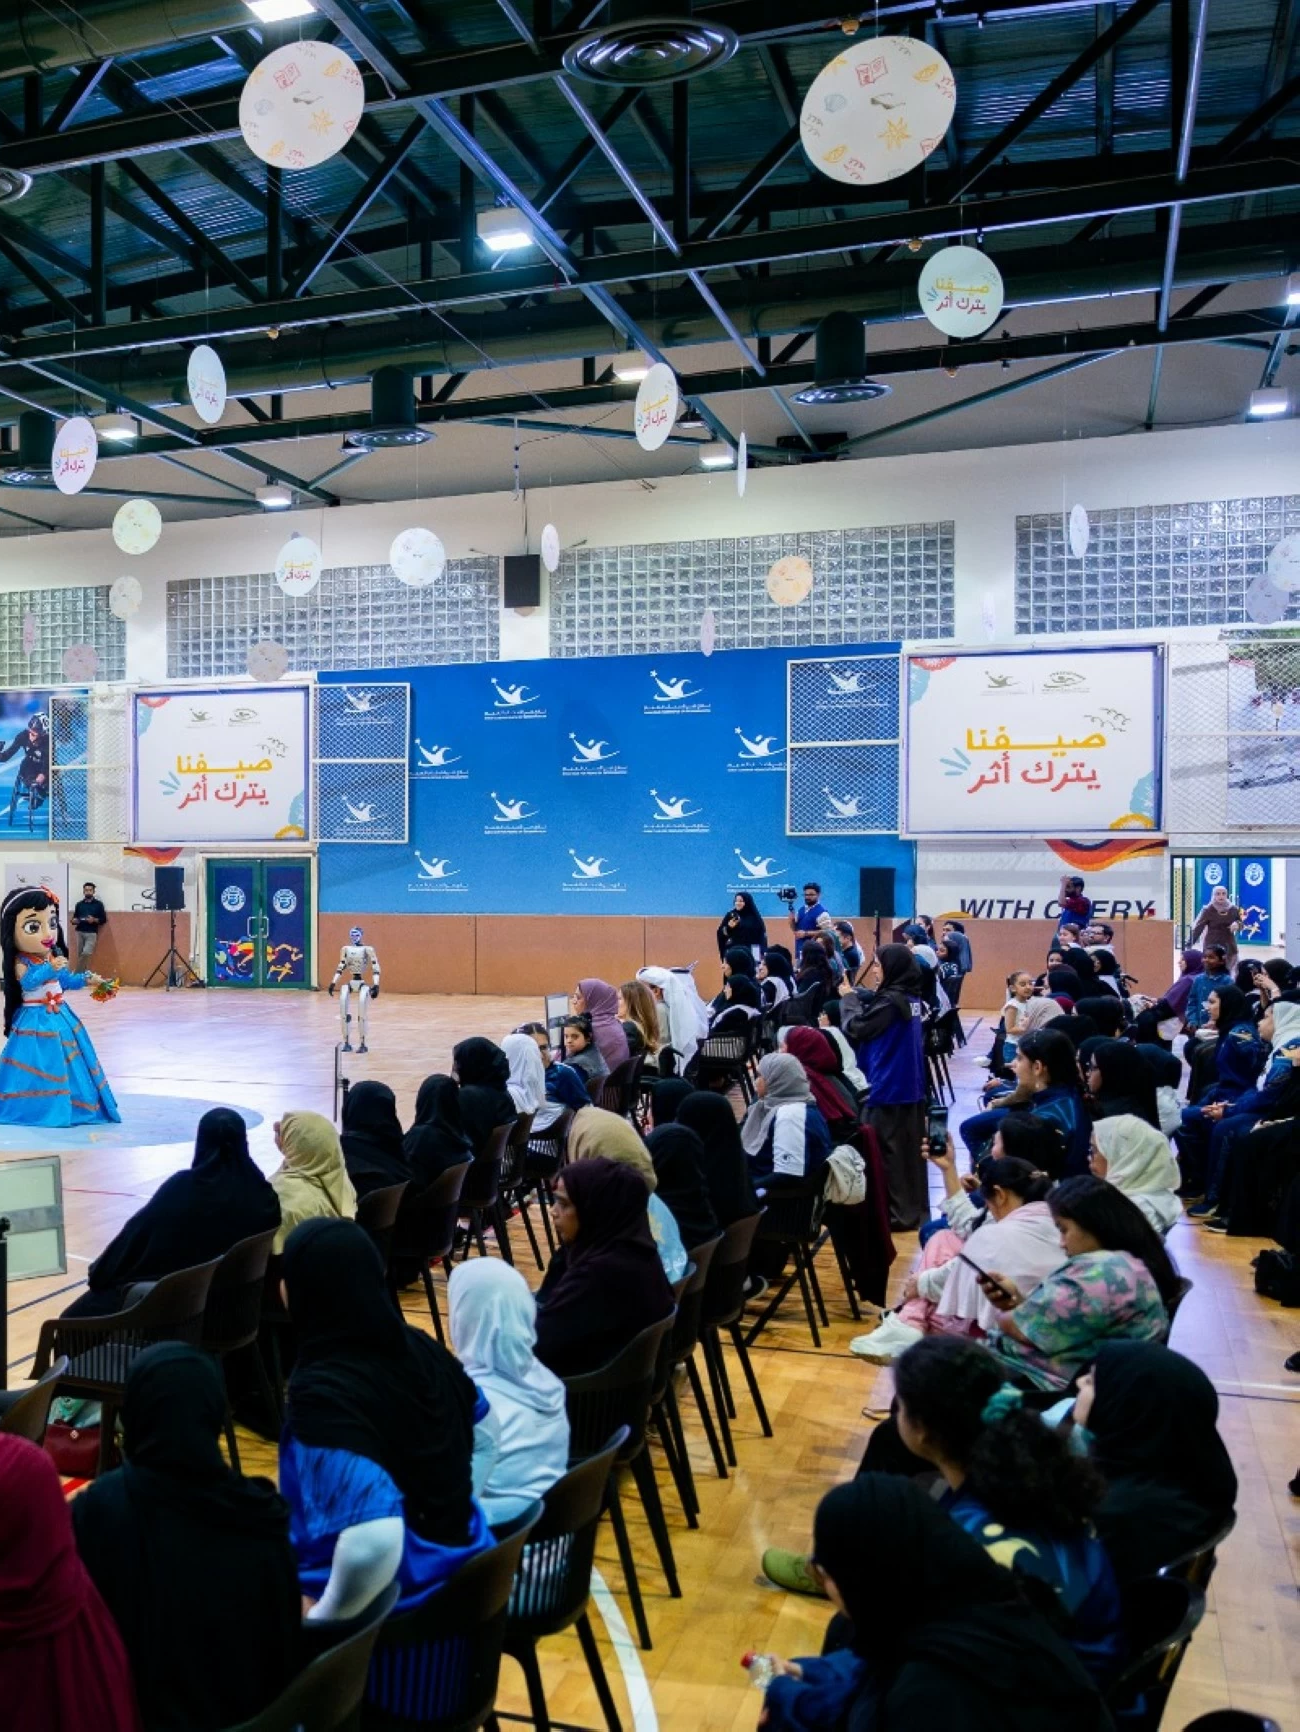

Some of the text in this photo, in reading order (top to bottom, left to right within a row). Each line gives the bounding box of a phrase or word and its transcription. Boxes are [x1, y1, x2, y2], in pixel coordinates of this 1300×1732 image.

[935, 277, 990, 294] صيفنا
[936, 293, 987, 314] يترك أثر
[966, 726, 1106, 757] صيفنا
[176, 752, 273, 779] صيفنا
[967, 751, 1102, 794] يترك أثر
[177, 774, 269, 810] يترك أثر
[959, 898, 1155, 920] WITH CERY
